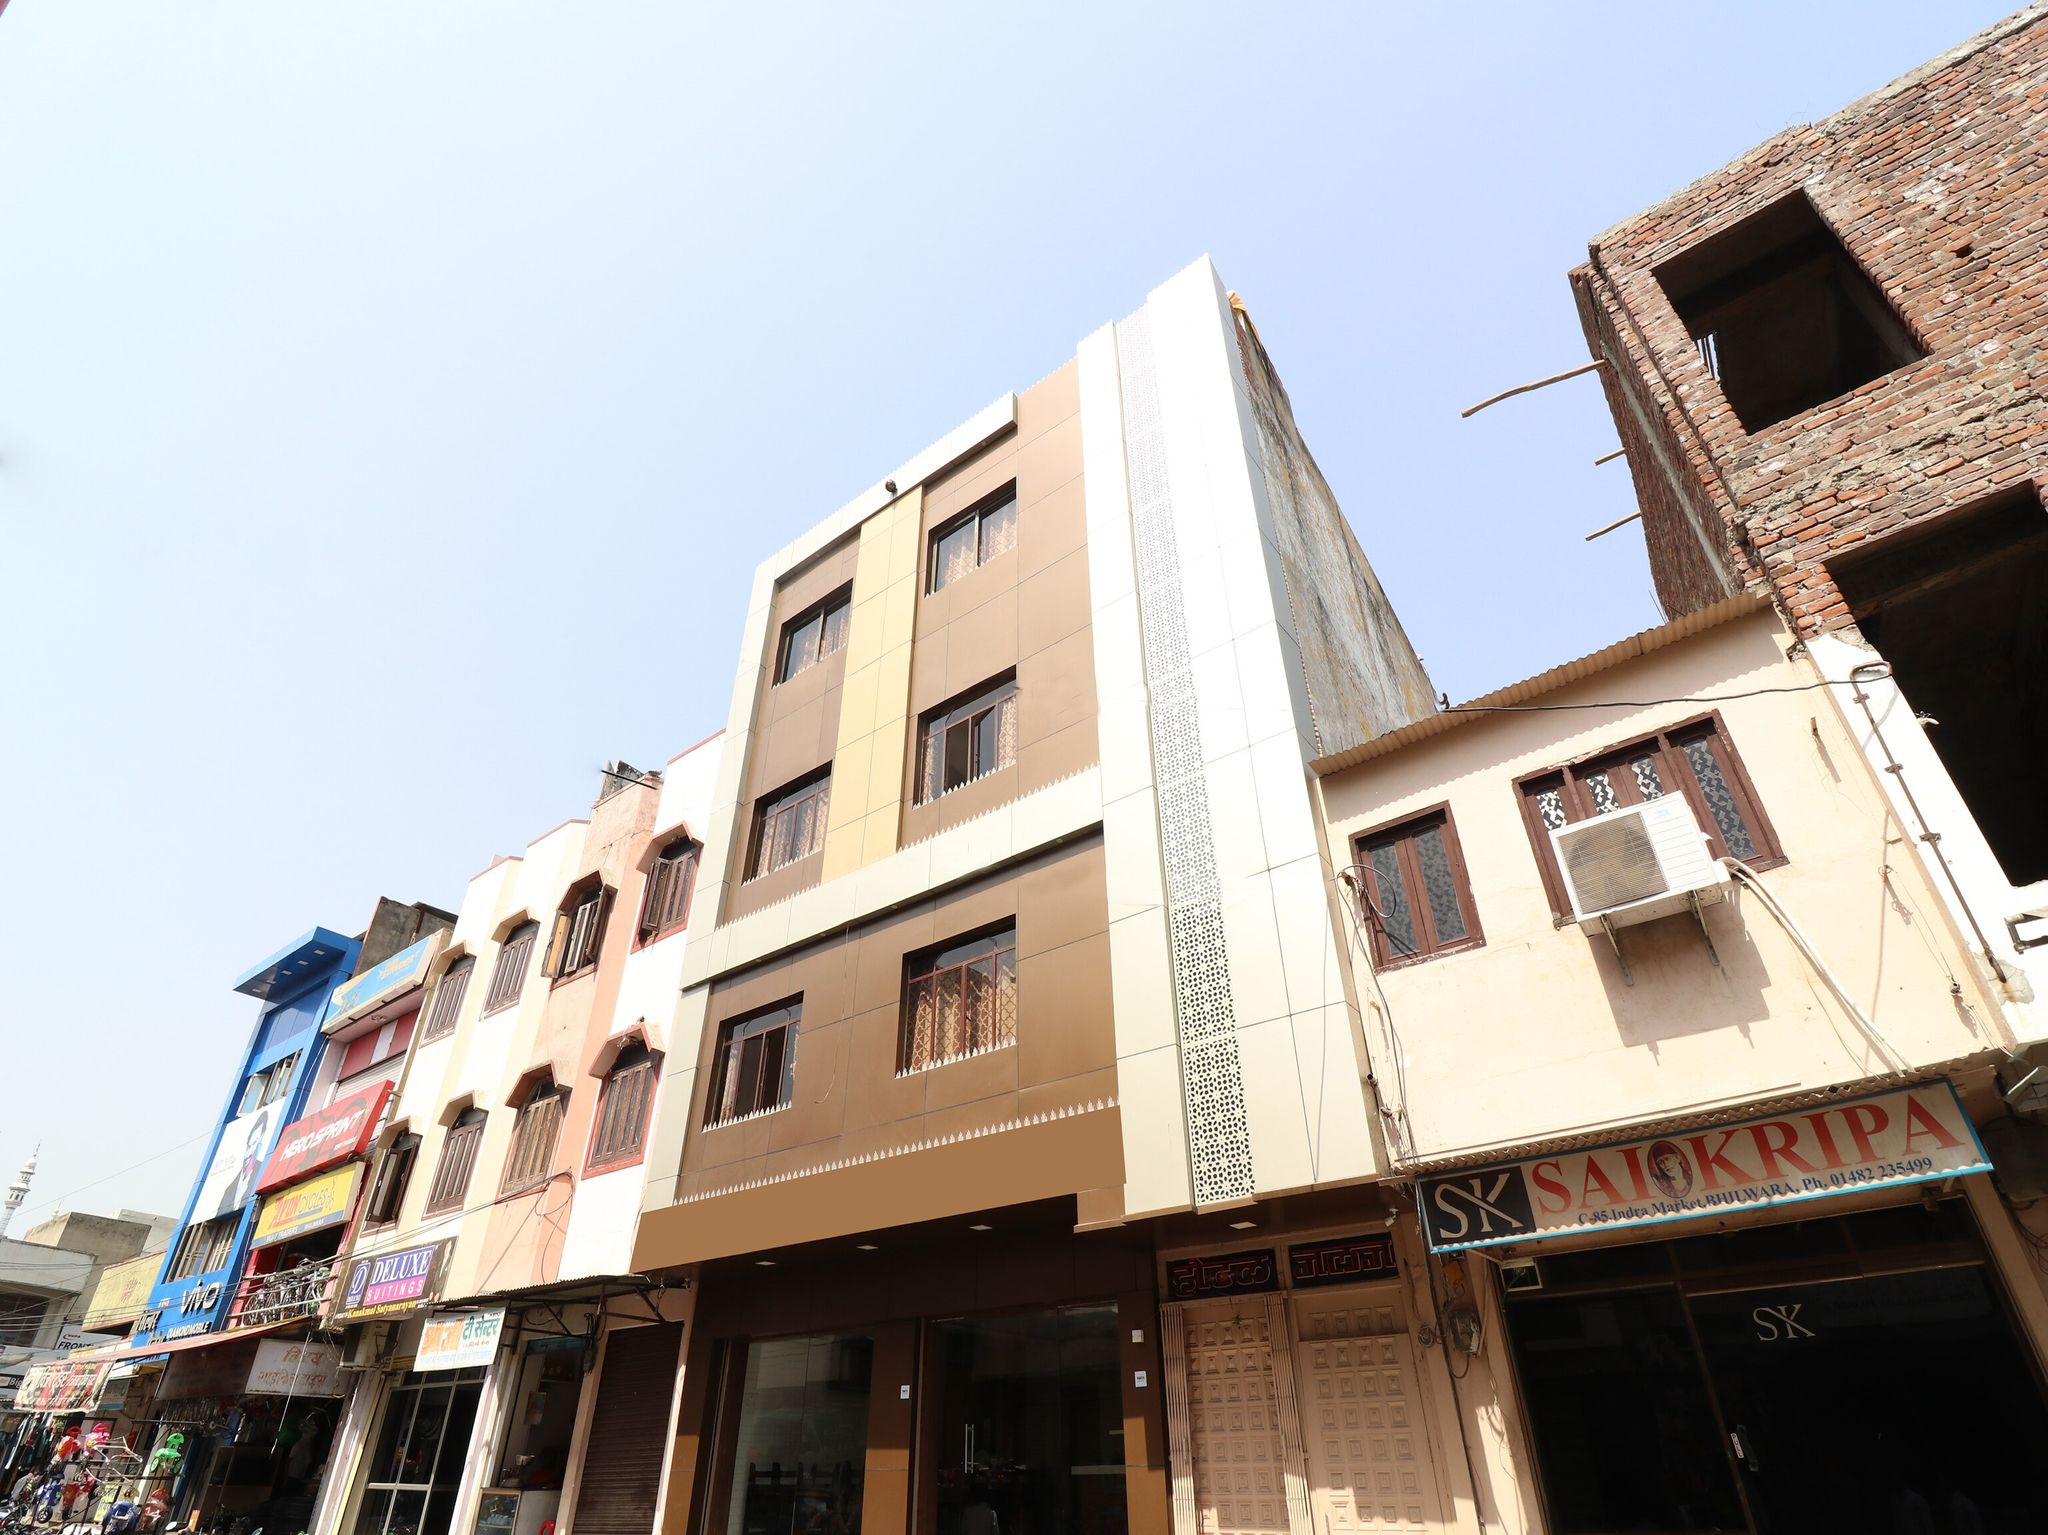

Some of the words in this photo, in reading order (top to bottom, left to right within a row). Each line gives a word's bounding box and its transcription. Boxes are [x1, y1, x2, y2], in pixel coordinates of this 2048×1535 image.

[1531, 1146, 1656, 1214] SAI
[1682, 1094, 1965, 1191] KRIPA
[1829, 1167, 1875, 1186] 01482
[1878, 1157, 1933, 1177] 235499
[1434, 1171, 1524, 1239] SK
[370, 1250, 433, 1285] DELUXE
[366, 1279, 424, 1301] SUITINGS
[1752, 1303, 1816, 1341] SK
